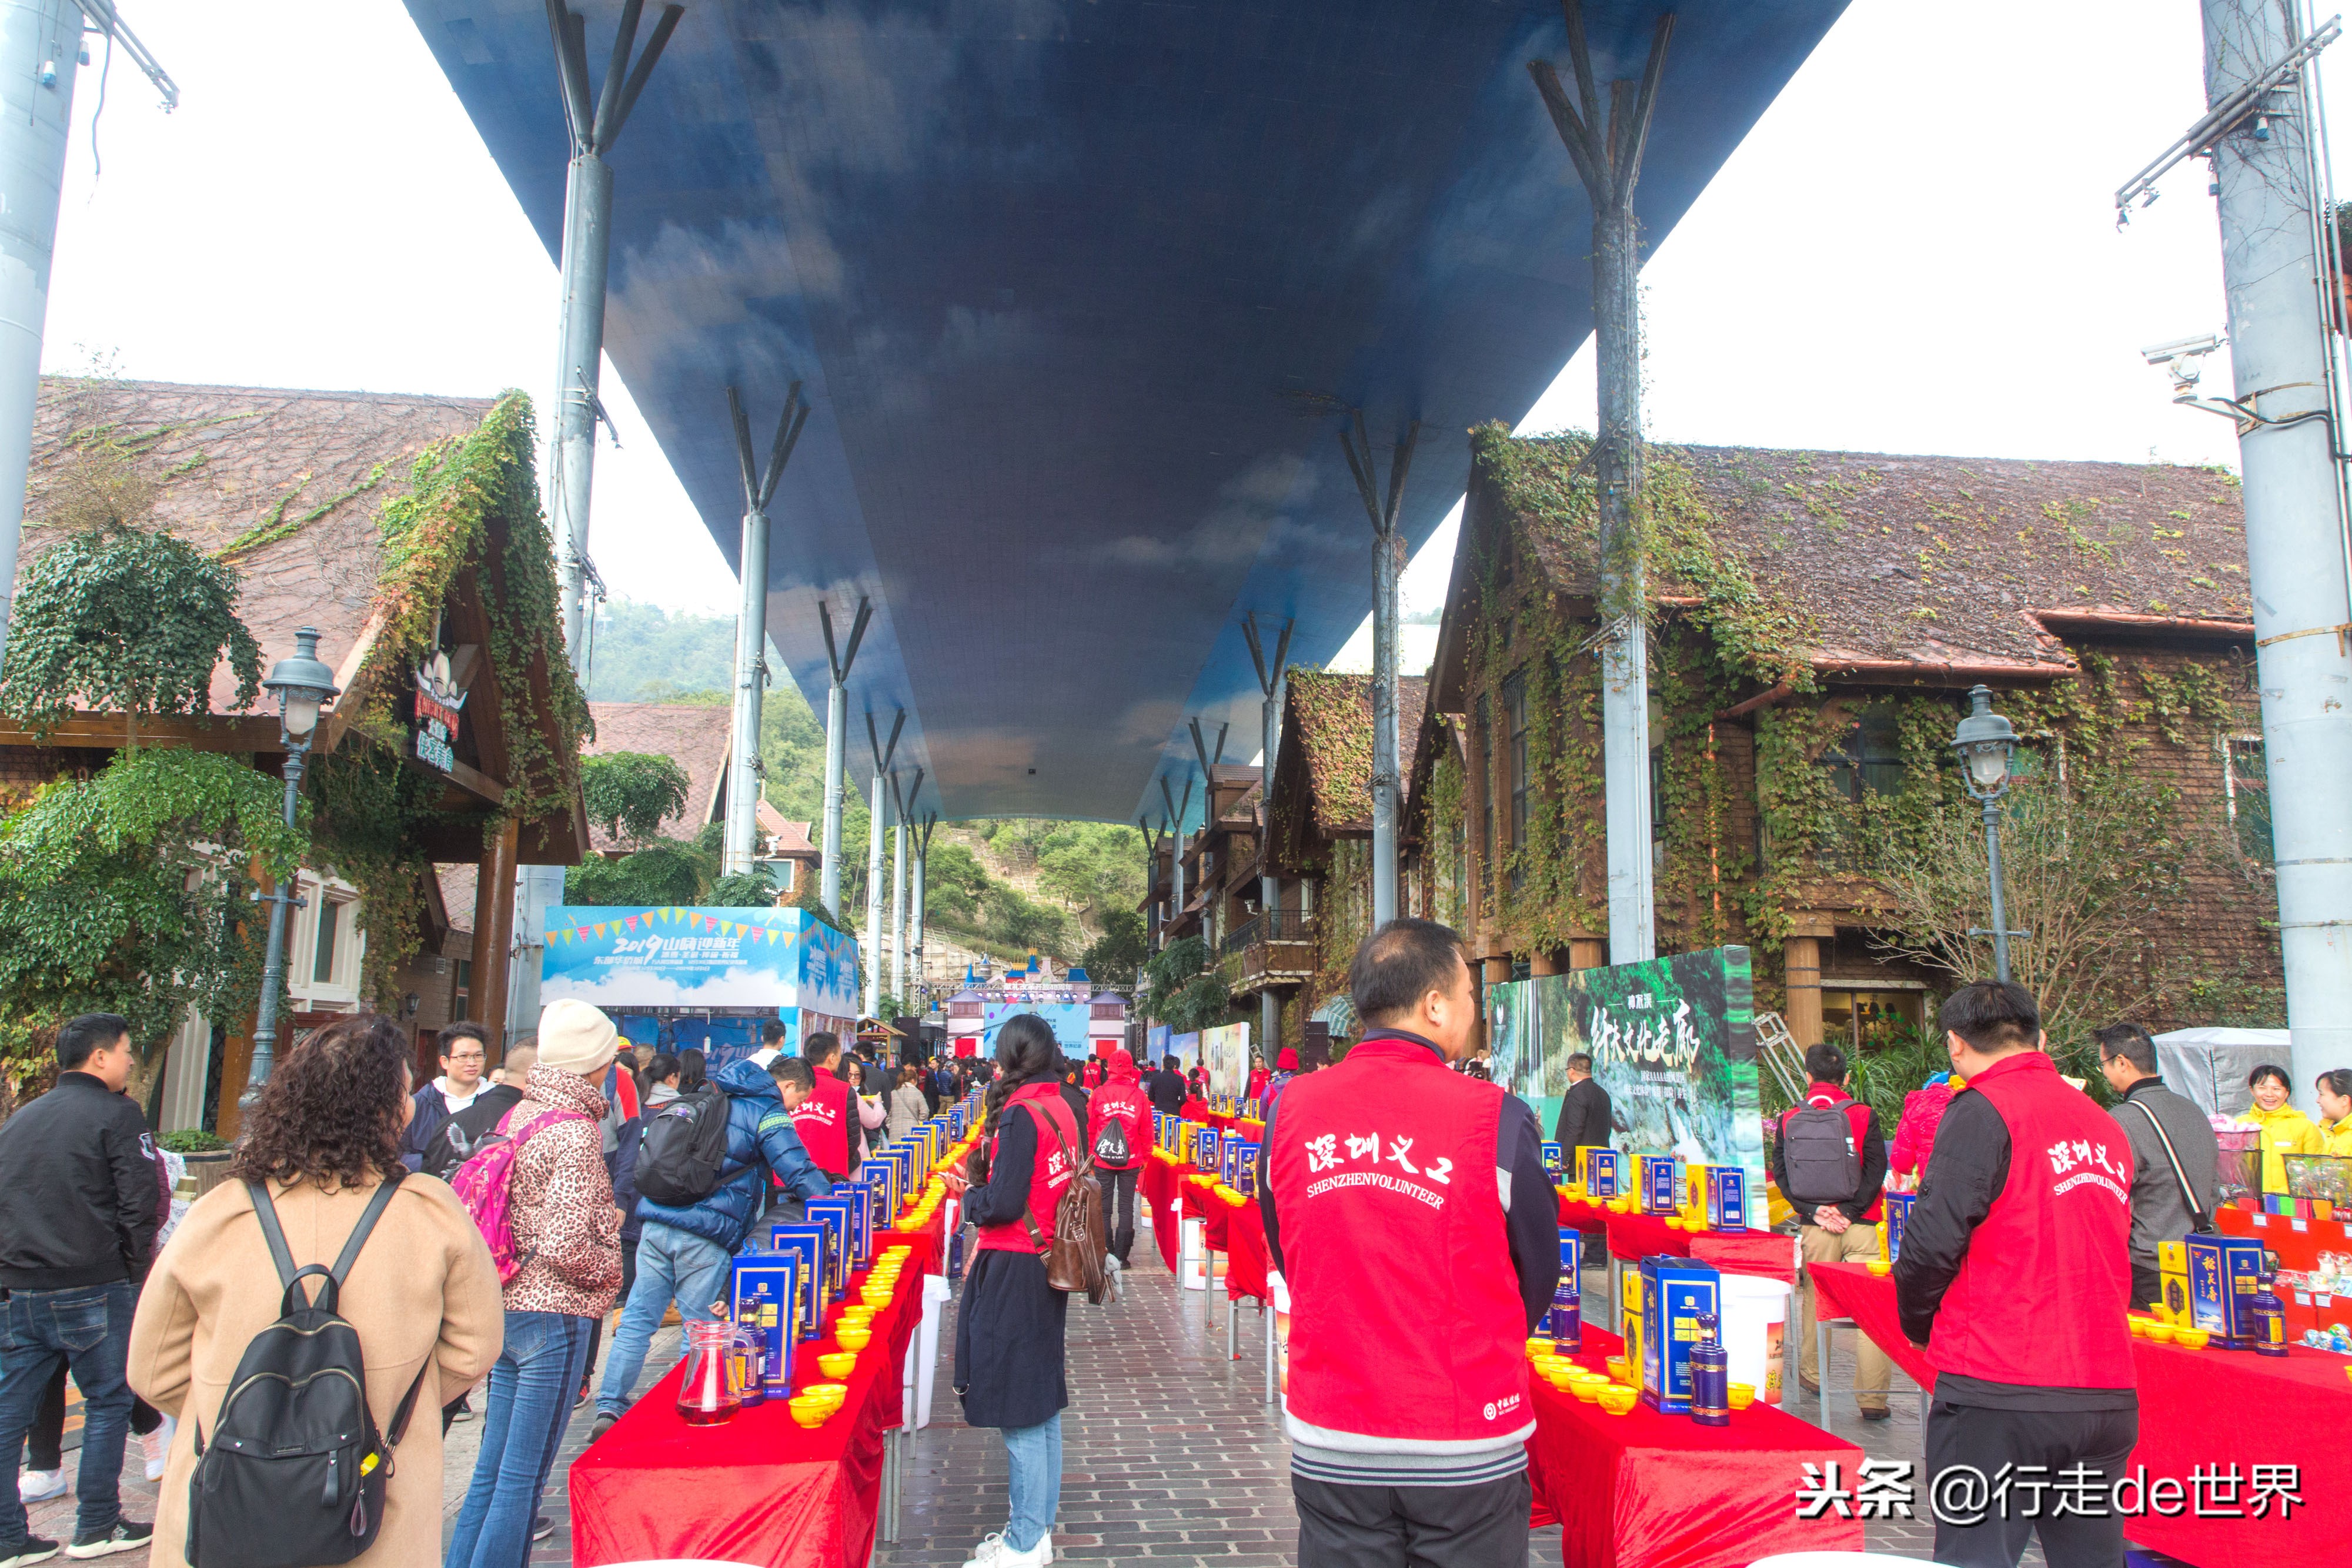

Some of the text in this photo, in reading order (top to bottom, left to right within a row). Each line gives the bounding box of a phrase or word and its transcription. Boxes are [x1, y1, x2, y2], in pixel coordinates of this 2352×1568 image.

[593, 956, 644, 965] 东部华侨城
[1628, 994, 1652, 1009] 神农溪
[1591, 998, 1700, 1074] 纤夫文化走廊
[1103, 1101, 1135, 1113] 深圳义工
[1305, 1132, 1453, 1185] 深圳义工
[2047, 1139, 2126, 1184] 深圳义工
[1307, 1172, 1445, 1210] SHENZHENVOLUNTEER
[2054, 1172, 2128, 1205] SHENZHENVOLUNTEER
[2202, 1256, 2218, 1302] 稻花香
